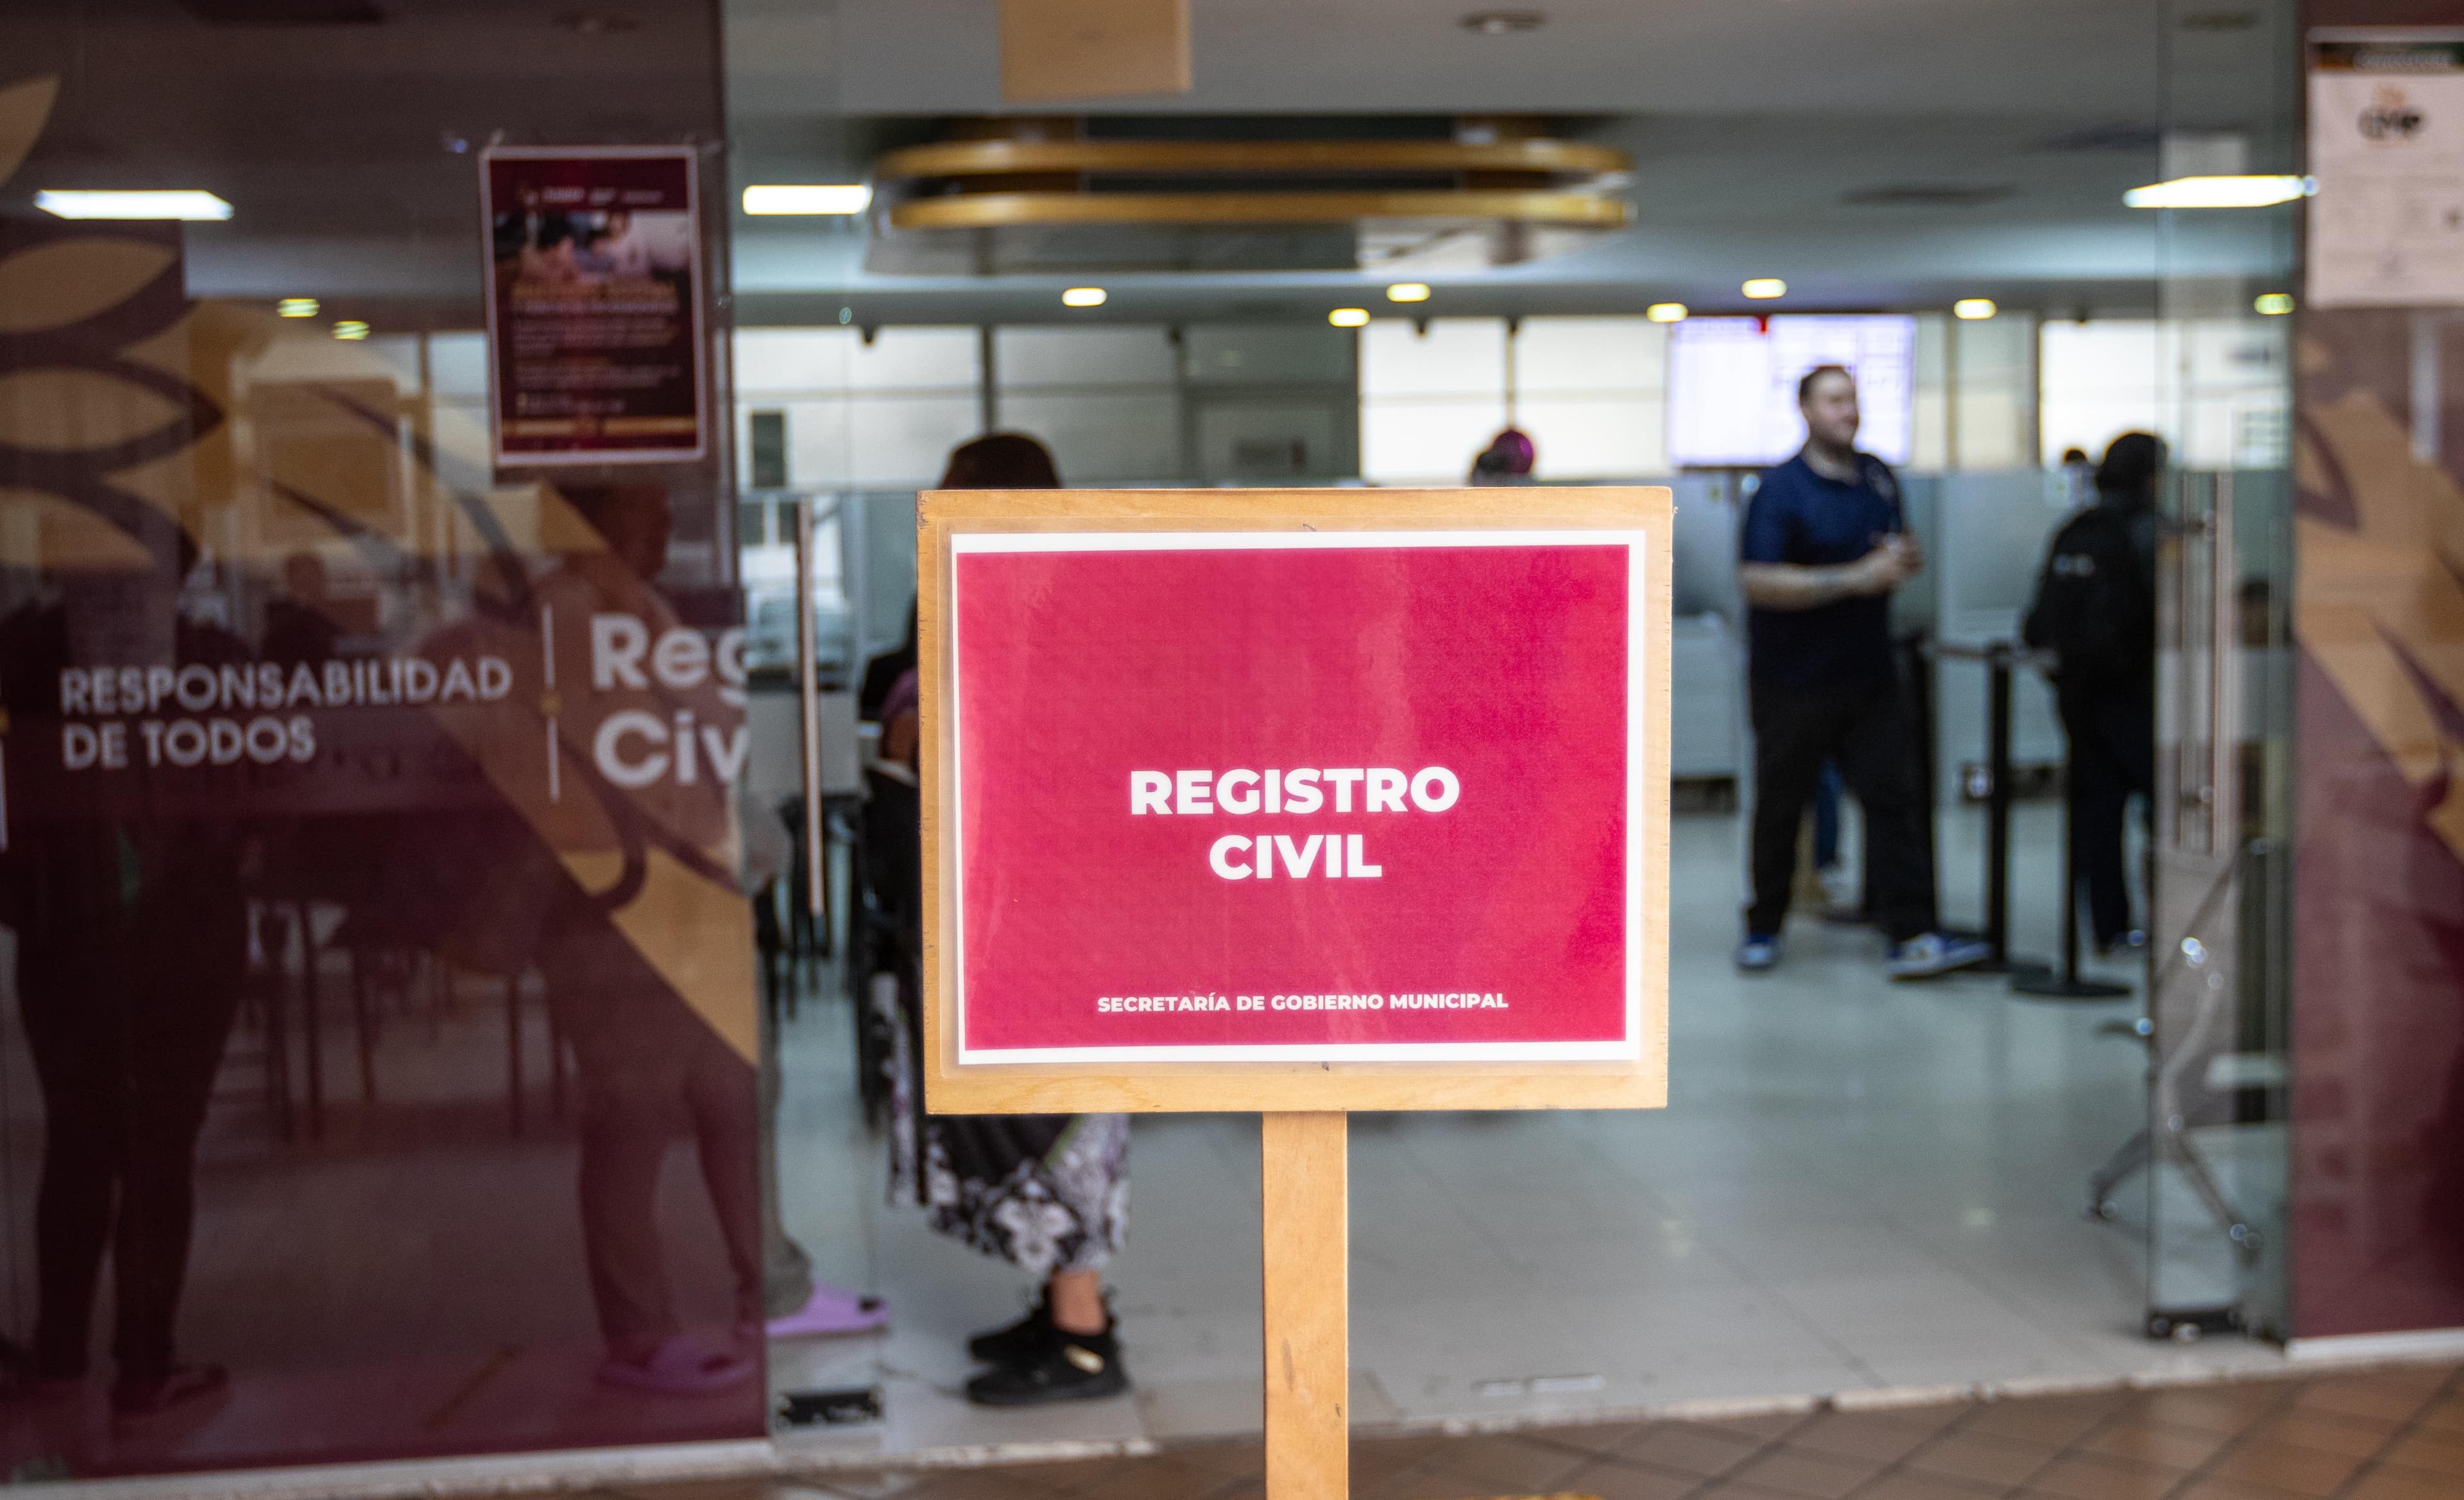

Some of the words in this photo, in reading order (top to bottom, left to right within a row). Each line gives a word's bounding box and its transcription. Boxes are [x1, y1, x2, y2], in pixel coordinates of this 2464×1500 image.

[61, 657, 512, 714] RESPONSABILIDAD
[64, 720, 128, 770] DE
[141, 715, 316, 766] TODOS
[594, 709, 749, 788] Civ
[1131, 766, 1460, 815] REGISTRO
[1209, 834, 1382, 880] CIVIL
[1097, 992, 1231, 1013] SECRETARÍA
[1236, 995, 1266, 1012] DE
[1270, 994, 1385, 1011] GOBIERNO
[1389, 992, 1510, 1010] MUNICIPAL
